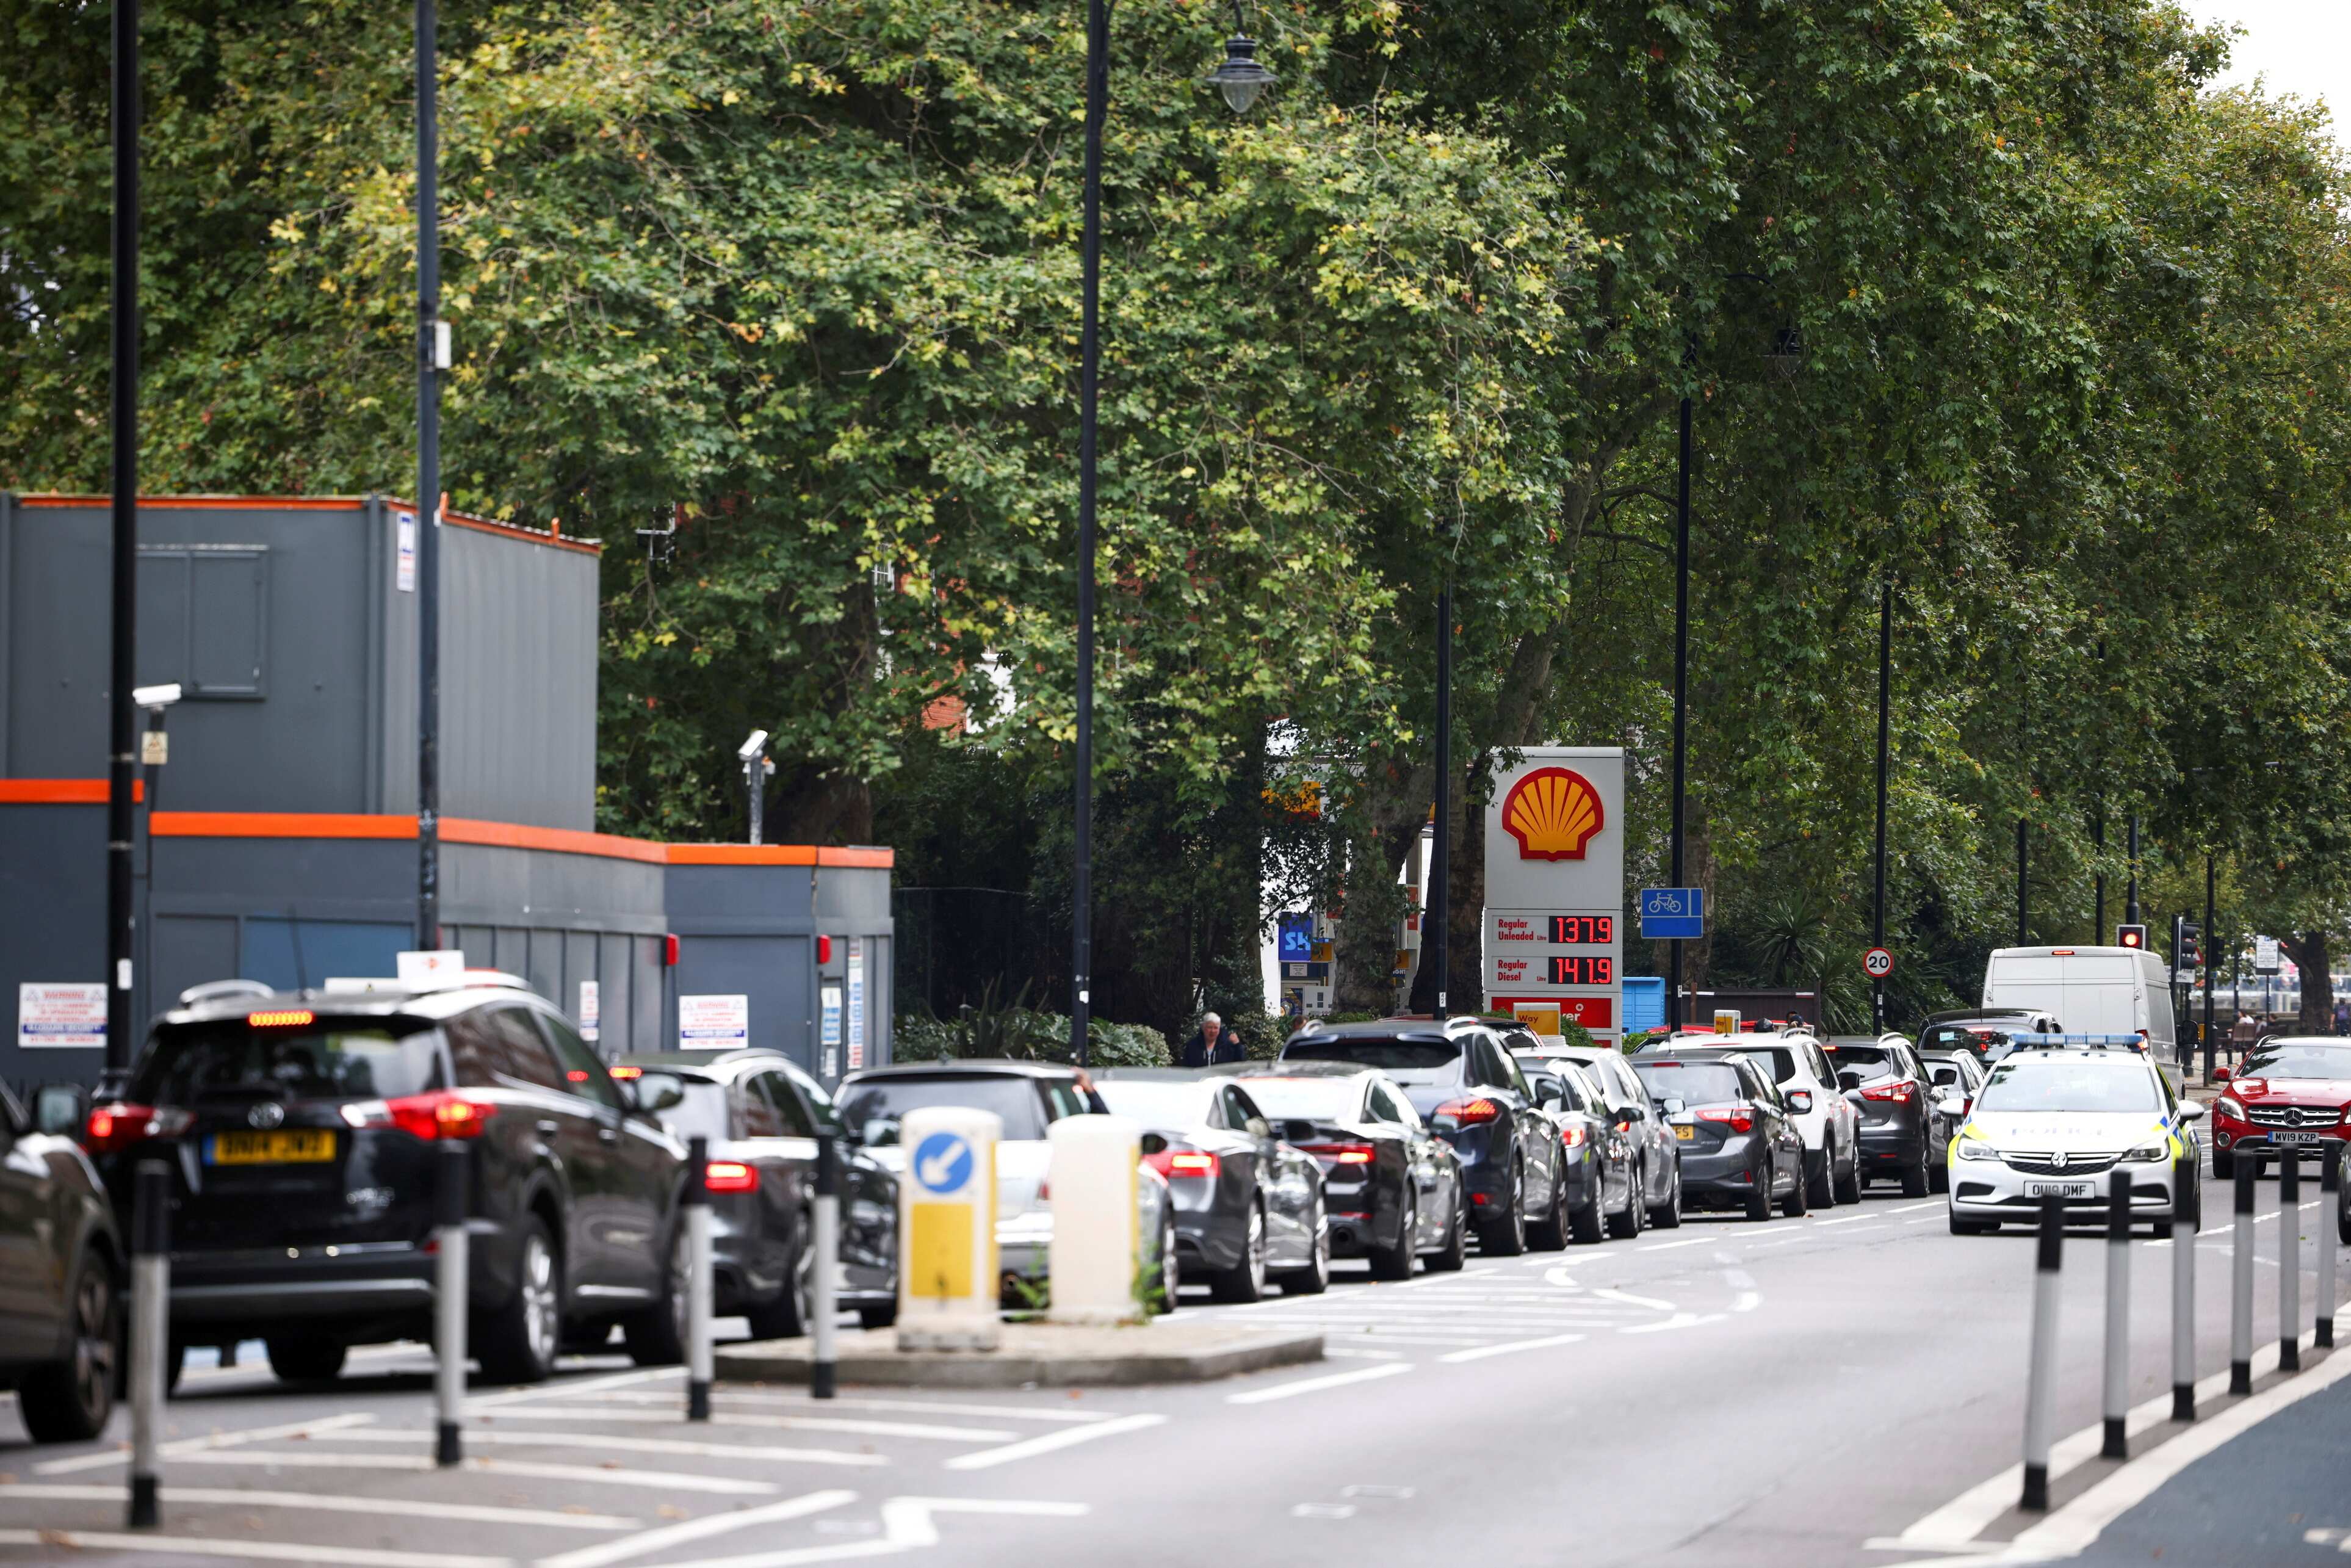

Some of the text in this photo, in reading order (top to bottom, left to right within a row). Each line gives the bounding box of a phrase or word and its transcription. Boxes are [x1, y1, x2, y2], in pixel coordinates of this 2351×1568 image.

[1498, 919, 1528, 930] Regular
[1557, 917, 1611, 942] 137.9
[1498, 931, 1534, 941] Unleaded
[1498, 959, 1528, 970] Regular
[1869, 956, 1889, 968] 20
[1556, 958, 1611, 983] 141.9
[1498, 972, 1521, 981] Diesel
[1519, 1015, 1539, 1024] Way
[2275, 1132, 2295, 1141] MV19
[2063, 1185, 2086, 1196] DMF
